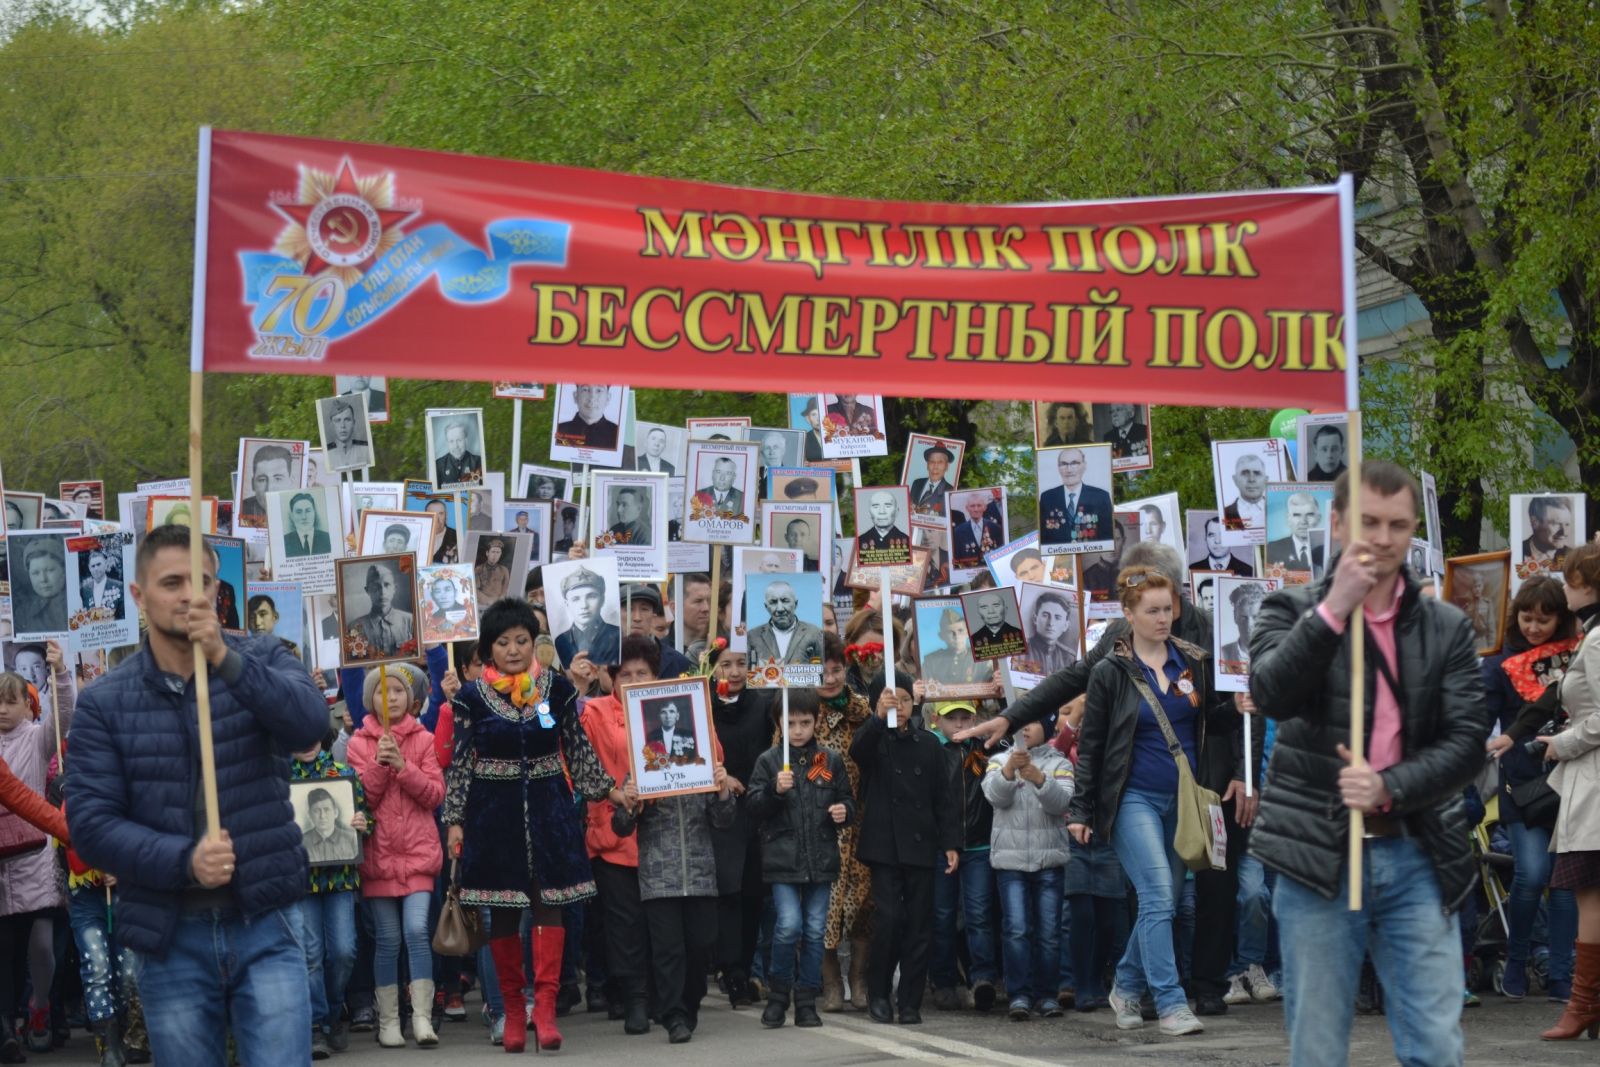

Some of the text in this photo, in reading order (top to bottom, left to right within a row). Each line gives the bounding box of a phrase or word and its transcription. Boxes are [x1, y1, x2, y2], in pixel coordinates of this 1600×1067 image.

[637, 206, 1260, 279] МӘҢГІЛІК ПОЛК
[258, 275, 345, 338] 70
[528, 281, 1347, 373] БЕССМЕРТНЫЙ ПОЛК
[251, 334, 328, 358] ЖЫЛ
[832, 436, 875, 446] МУКАНОВ
[698, 519, 744, 530] ОМАРОВ
[1047, 545, 1081, 554] Сибанов
[784, 664, 824, 674] АМИНОВ
[788, 674, 820, 684] КАДЫР
[629, 683, 700, 698] БЕССМЕРТНЫЙ ПОЛК
[663, 771, 686, 783] Гузь
[640, 783, 672, 794] Николай
